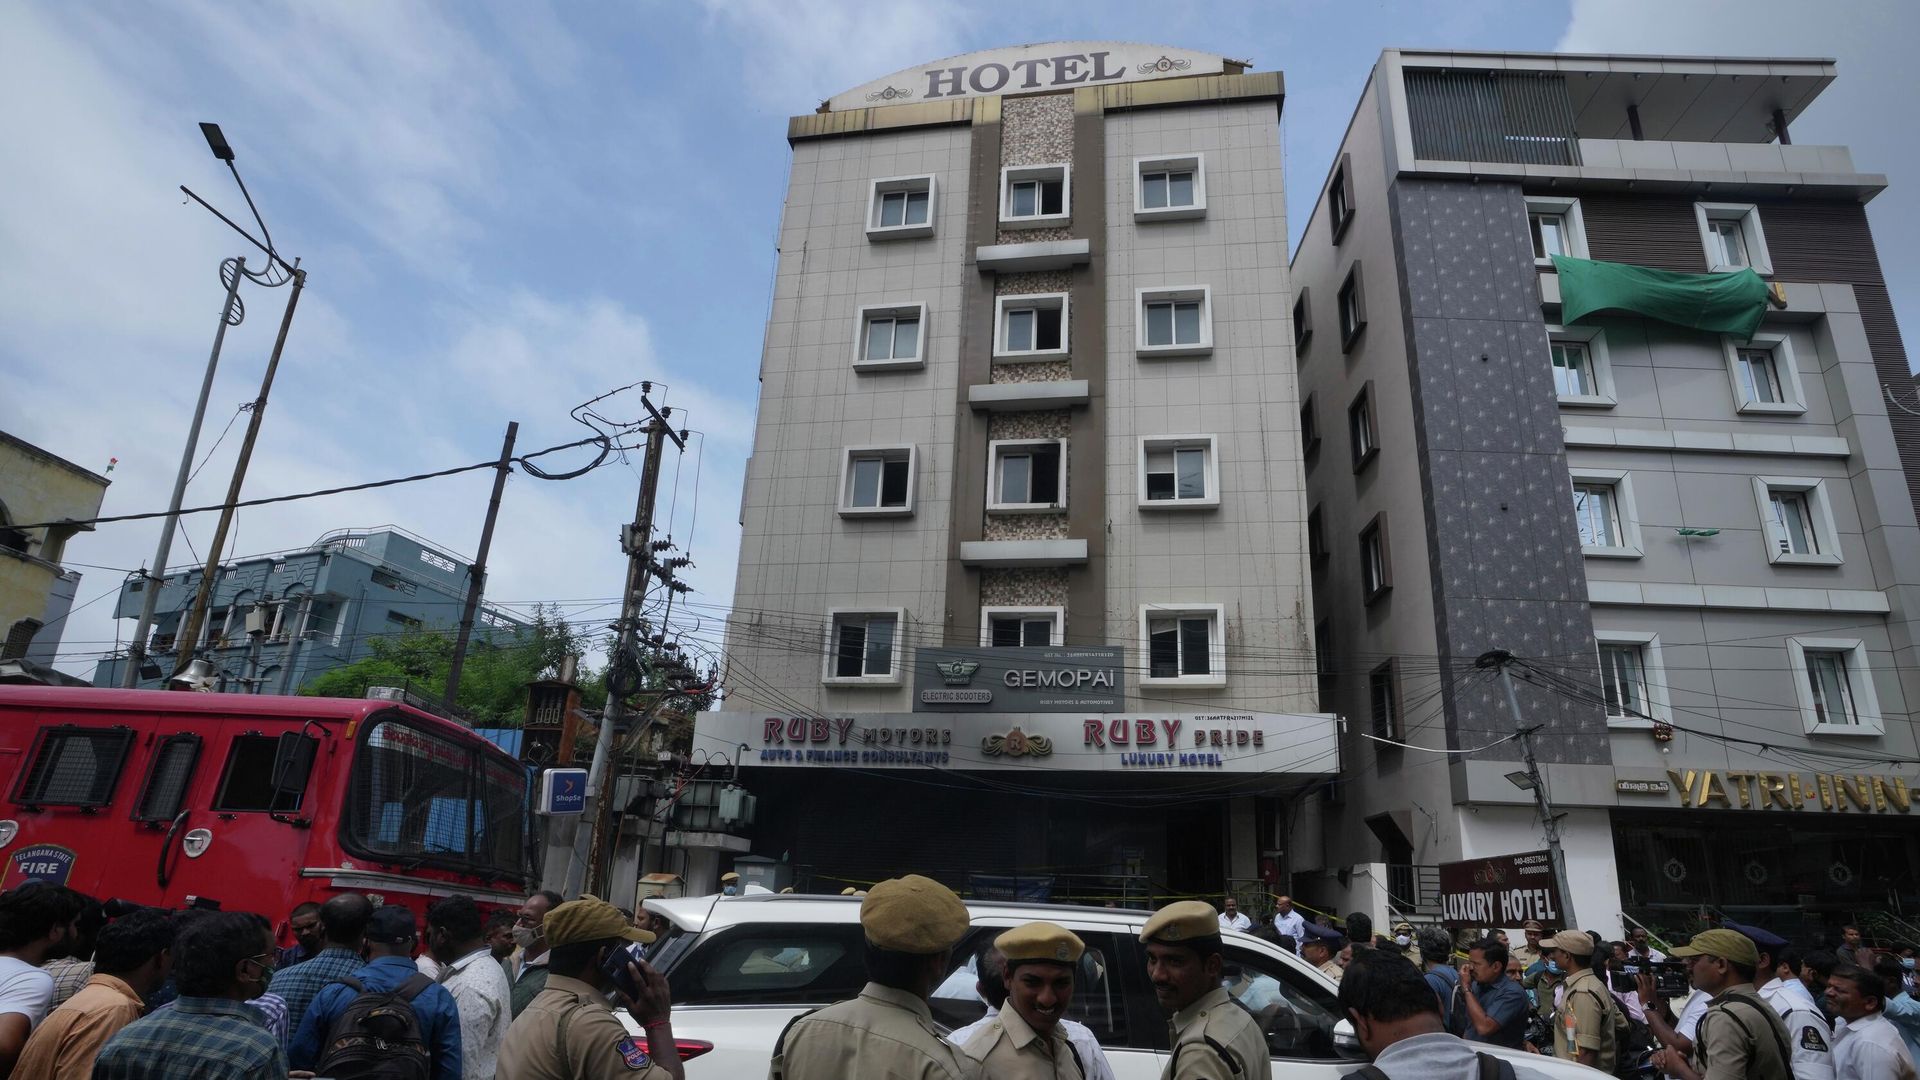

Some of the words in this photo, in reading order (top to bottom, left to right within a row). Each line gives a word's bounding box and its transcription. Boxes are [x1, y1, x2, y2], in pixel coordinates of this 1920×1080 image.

[923, 51, 1126, 98] HOTEL
[1003, 669, 1115, 687] GEMOPAI
[922, 692, 954, 701] ELECTRIC
[956, 692, 991, 701] SCOOTERS
[763, 718, 854, 744] RUBY
[863, 727, 951, 744] MOTORS
[1083, 719, 1182, 748] RUBY
[1194, 730, 1264, 746] PRIDE
[760, 749, 791, 761] AUTO
[795, 750, 804, 761] &
[807, 750, 858, 762] FINANCE
[862, 751, 949, 763] CONSULTANTS
[1121, 752, 1174, 766] LUXURY
[1179, 753, 1222, 767] HOTEL
[555, 794, 582, 803] ShopSe
[1666, 769, 1806, 810] YATRI
[1815, 772, 1911, 813] INN
[15, 849, 53, 862] TELANGANA
[53, 851, 71, 863] STATE
[18, 862, 58, 874] FIRE
[1442, 891, 1494, 924] LUXURY
[1500, 888, 1556, 924] HOTEL
